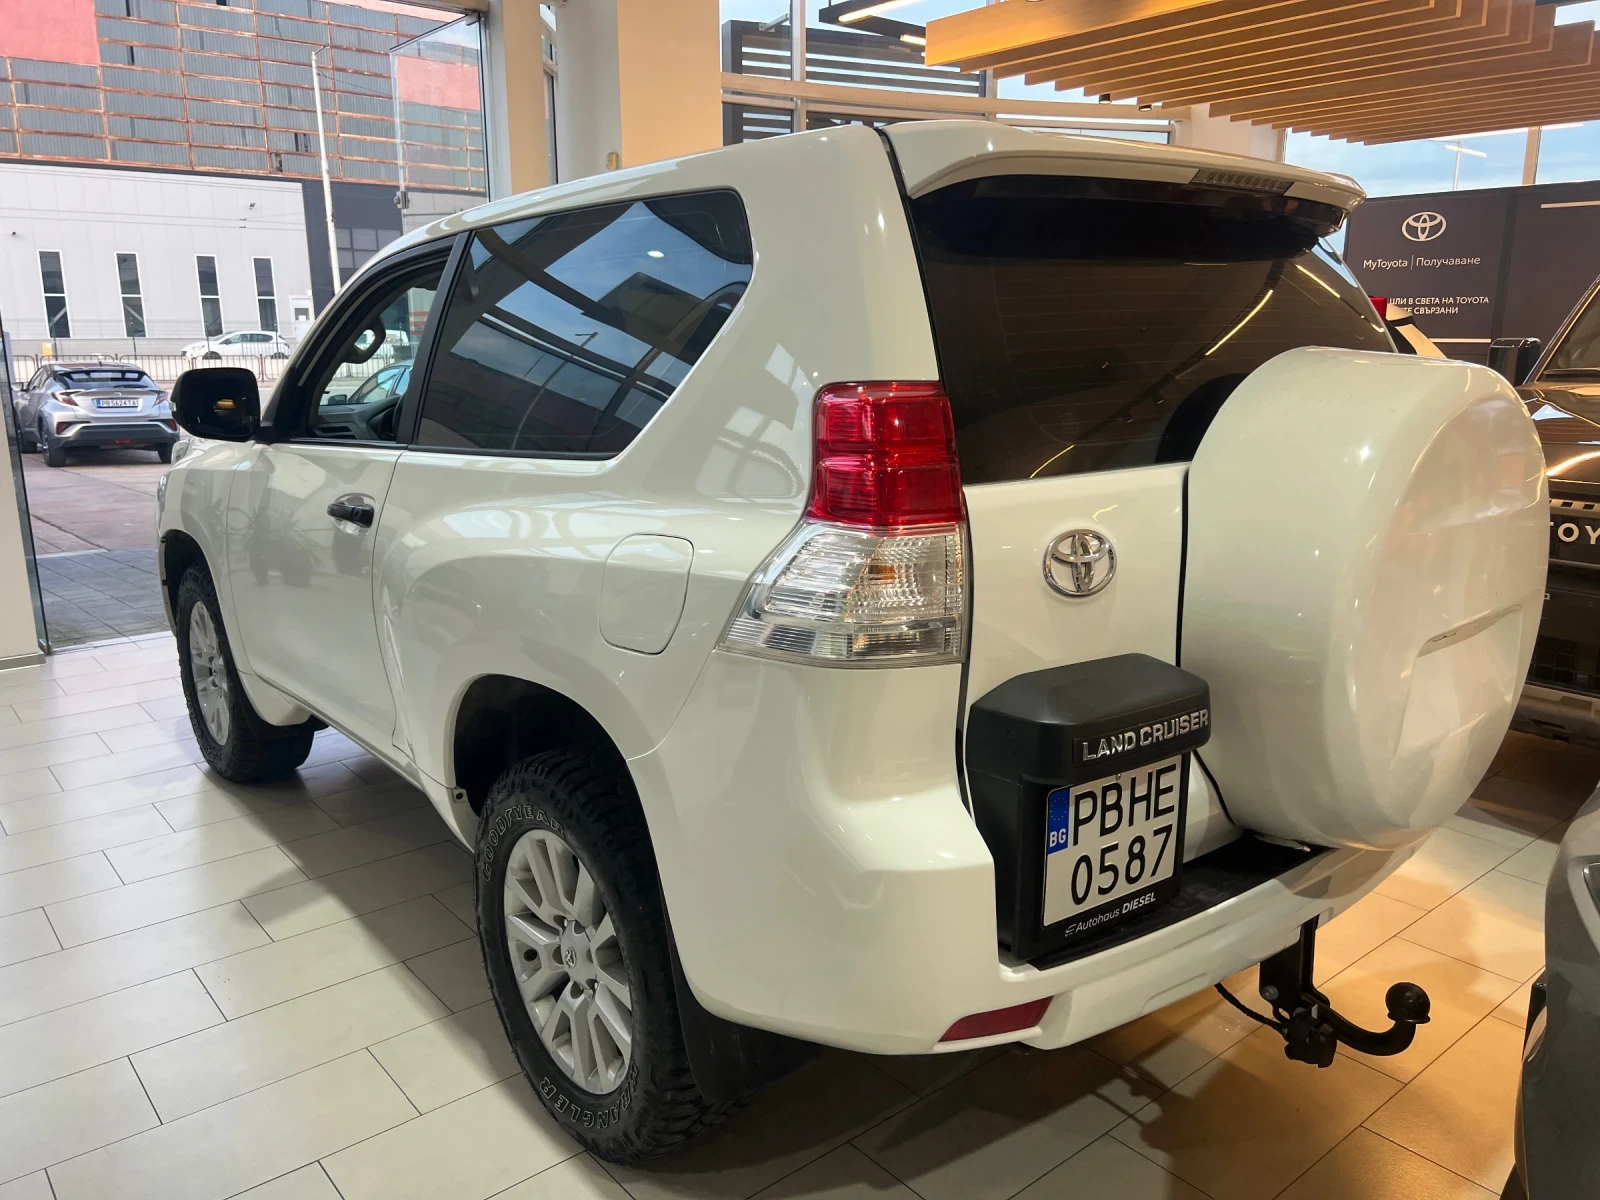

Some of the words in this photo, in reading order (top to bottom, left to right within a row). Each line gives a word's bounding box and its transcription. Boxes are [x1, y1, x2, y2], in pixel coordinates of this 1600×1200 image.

[1363, 258, 1408, 270] MyToyota
[1416, 256, 1481, 267] Получаване
[1414, 307, 1459, 315] СВЪРЗАНИ
[1415, 297, 1440, 305] СВЕТА
[1456, 296, 1490, 304] TOYOTA
[1550, 521, 1600, 545] OY
[1082, 731, 1137, 762] LAND
[1139, 709, 1209, 747] CRUISER
[1072, 763, 1177, 847] PBHE
[482, 805, 565, 882] GOODYEAR
[1049, 831, 1067, 848] BG
[1071, 823, 1173, 906] 0587
[1075, 908, 1120, 933] Autohaus
[1121, 892, 1156, 914] DIESEL
[540, 1060, 638, 1129] WRANGLER
